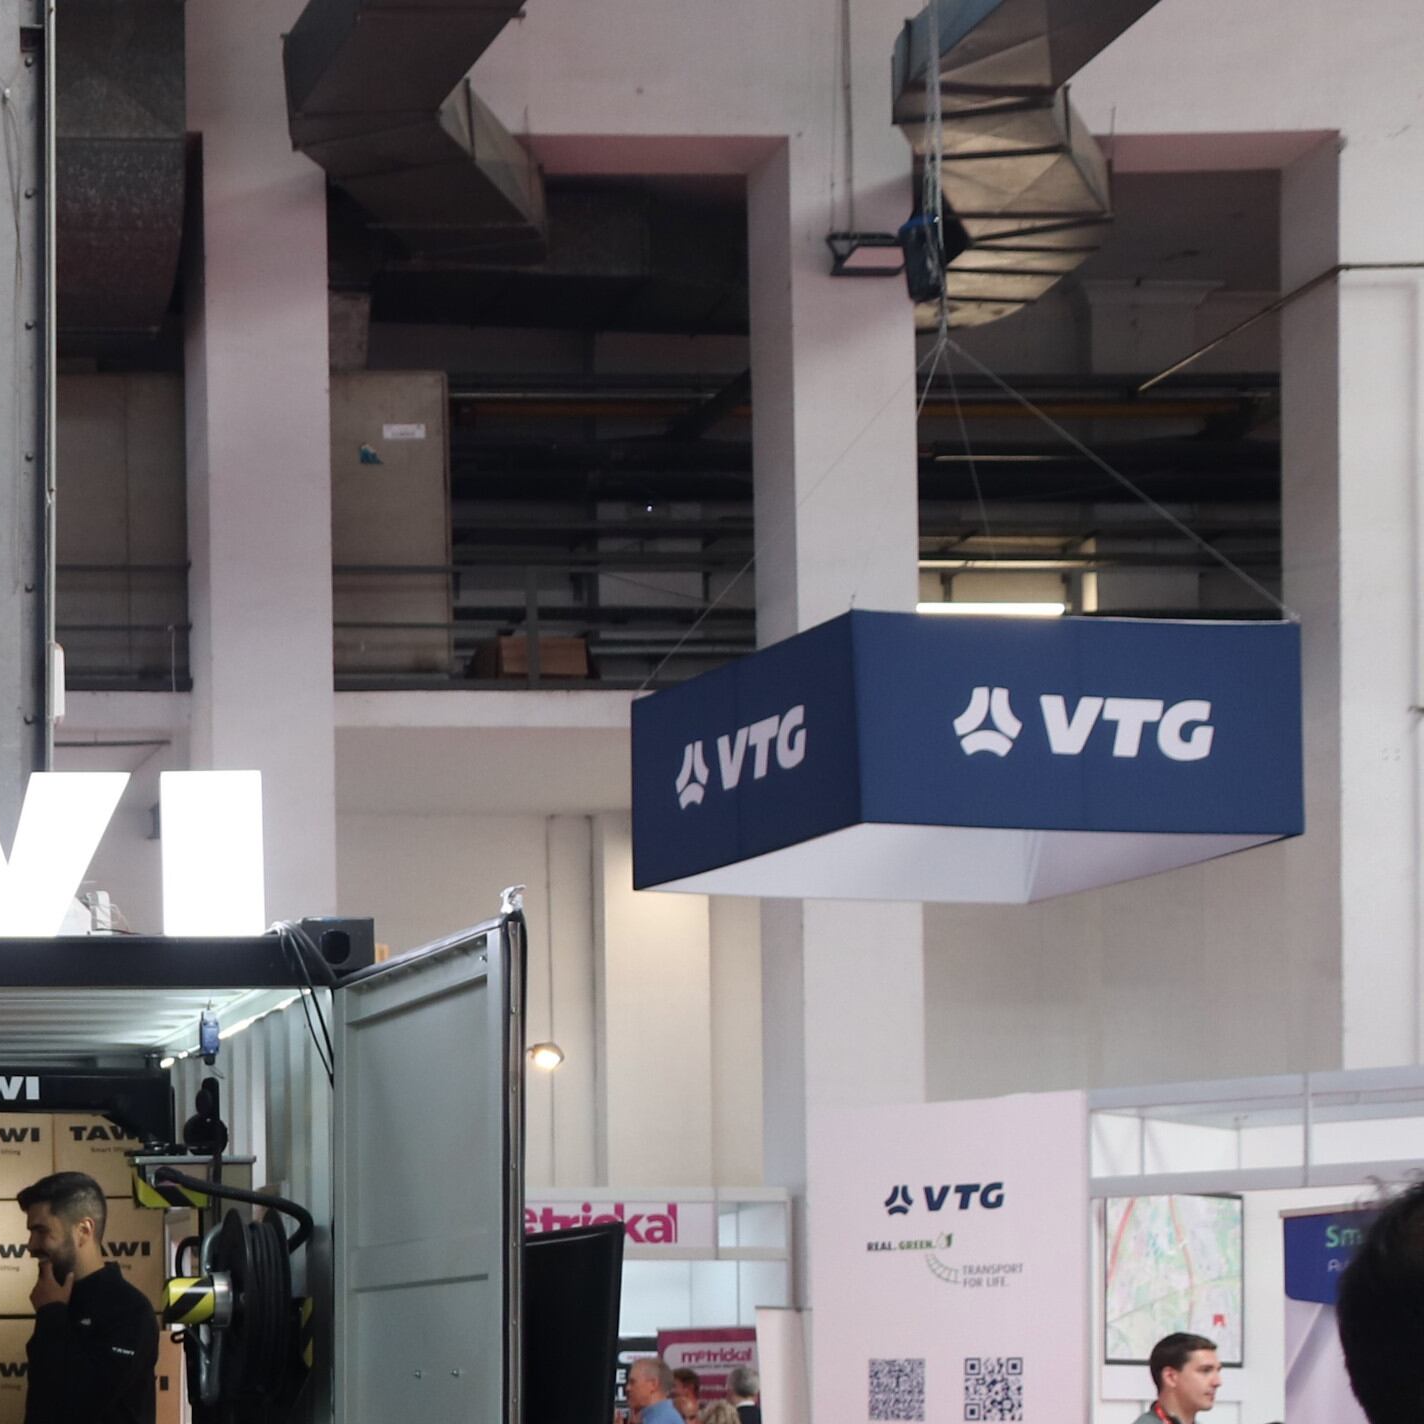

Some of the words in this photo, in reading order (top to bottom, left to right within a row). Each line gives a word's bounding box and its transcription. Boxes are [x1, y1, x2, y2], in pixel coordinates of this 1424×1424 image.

[1040, 694, 1214, 761] VTG
[716, 705, 807, 792] VTG
[69, 1125, 142, 1141] TAW
[923, 1182, 1005, 1212] VTG
[524, 1202, 678, 1244] etrikal
[101, 1241, 150, 1257] WI
[963, 1263, 1024, 1276] TRANSPORT
[963, 1277, 983, 1288] FOR
